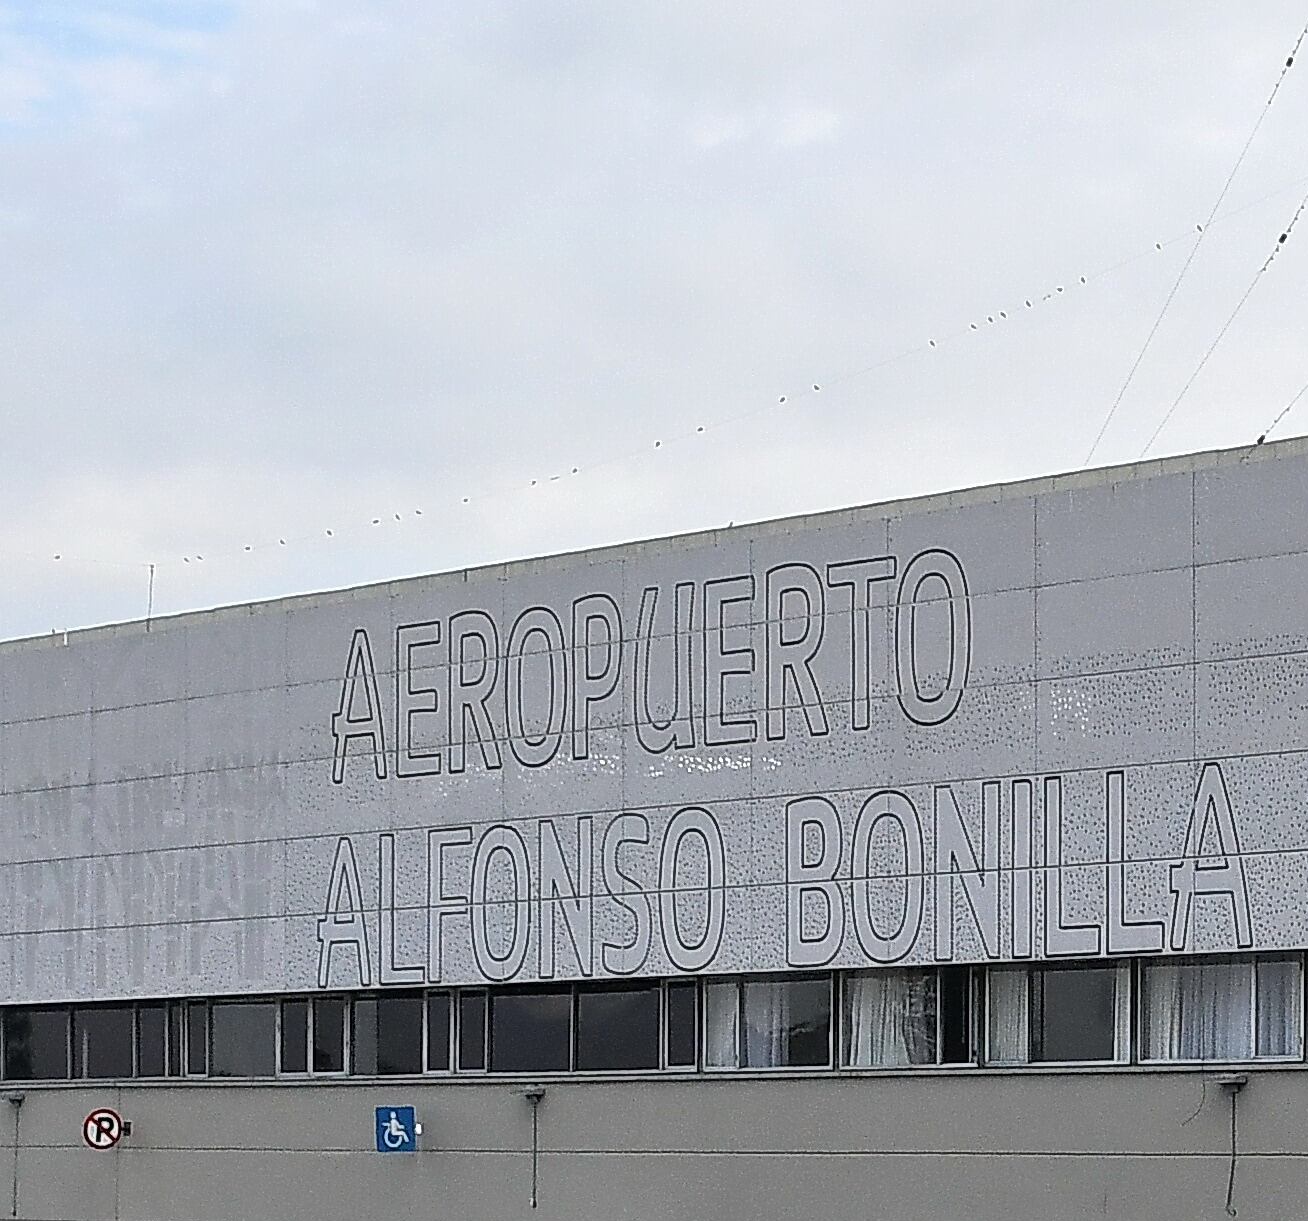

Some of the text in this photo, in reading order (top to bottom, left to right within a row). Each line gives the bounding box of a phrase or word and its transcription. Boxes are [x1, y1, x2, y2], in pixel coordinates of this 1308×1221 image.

[331, 549, 971, 783] AEROPUERTO
[317, 806, 726, 988] ALFONSO
[786, 762, 1253, 967] BONILLA
